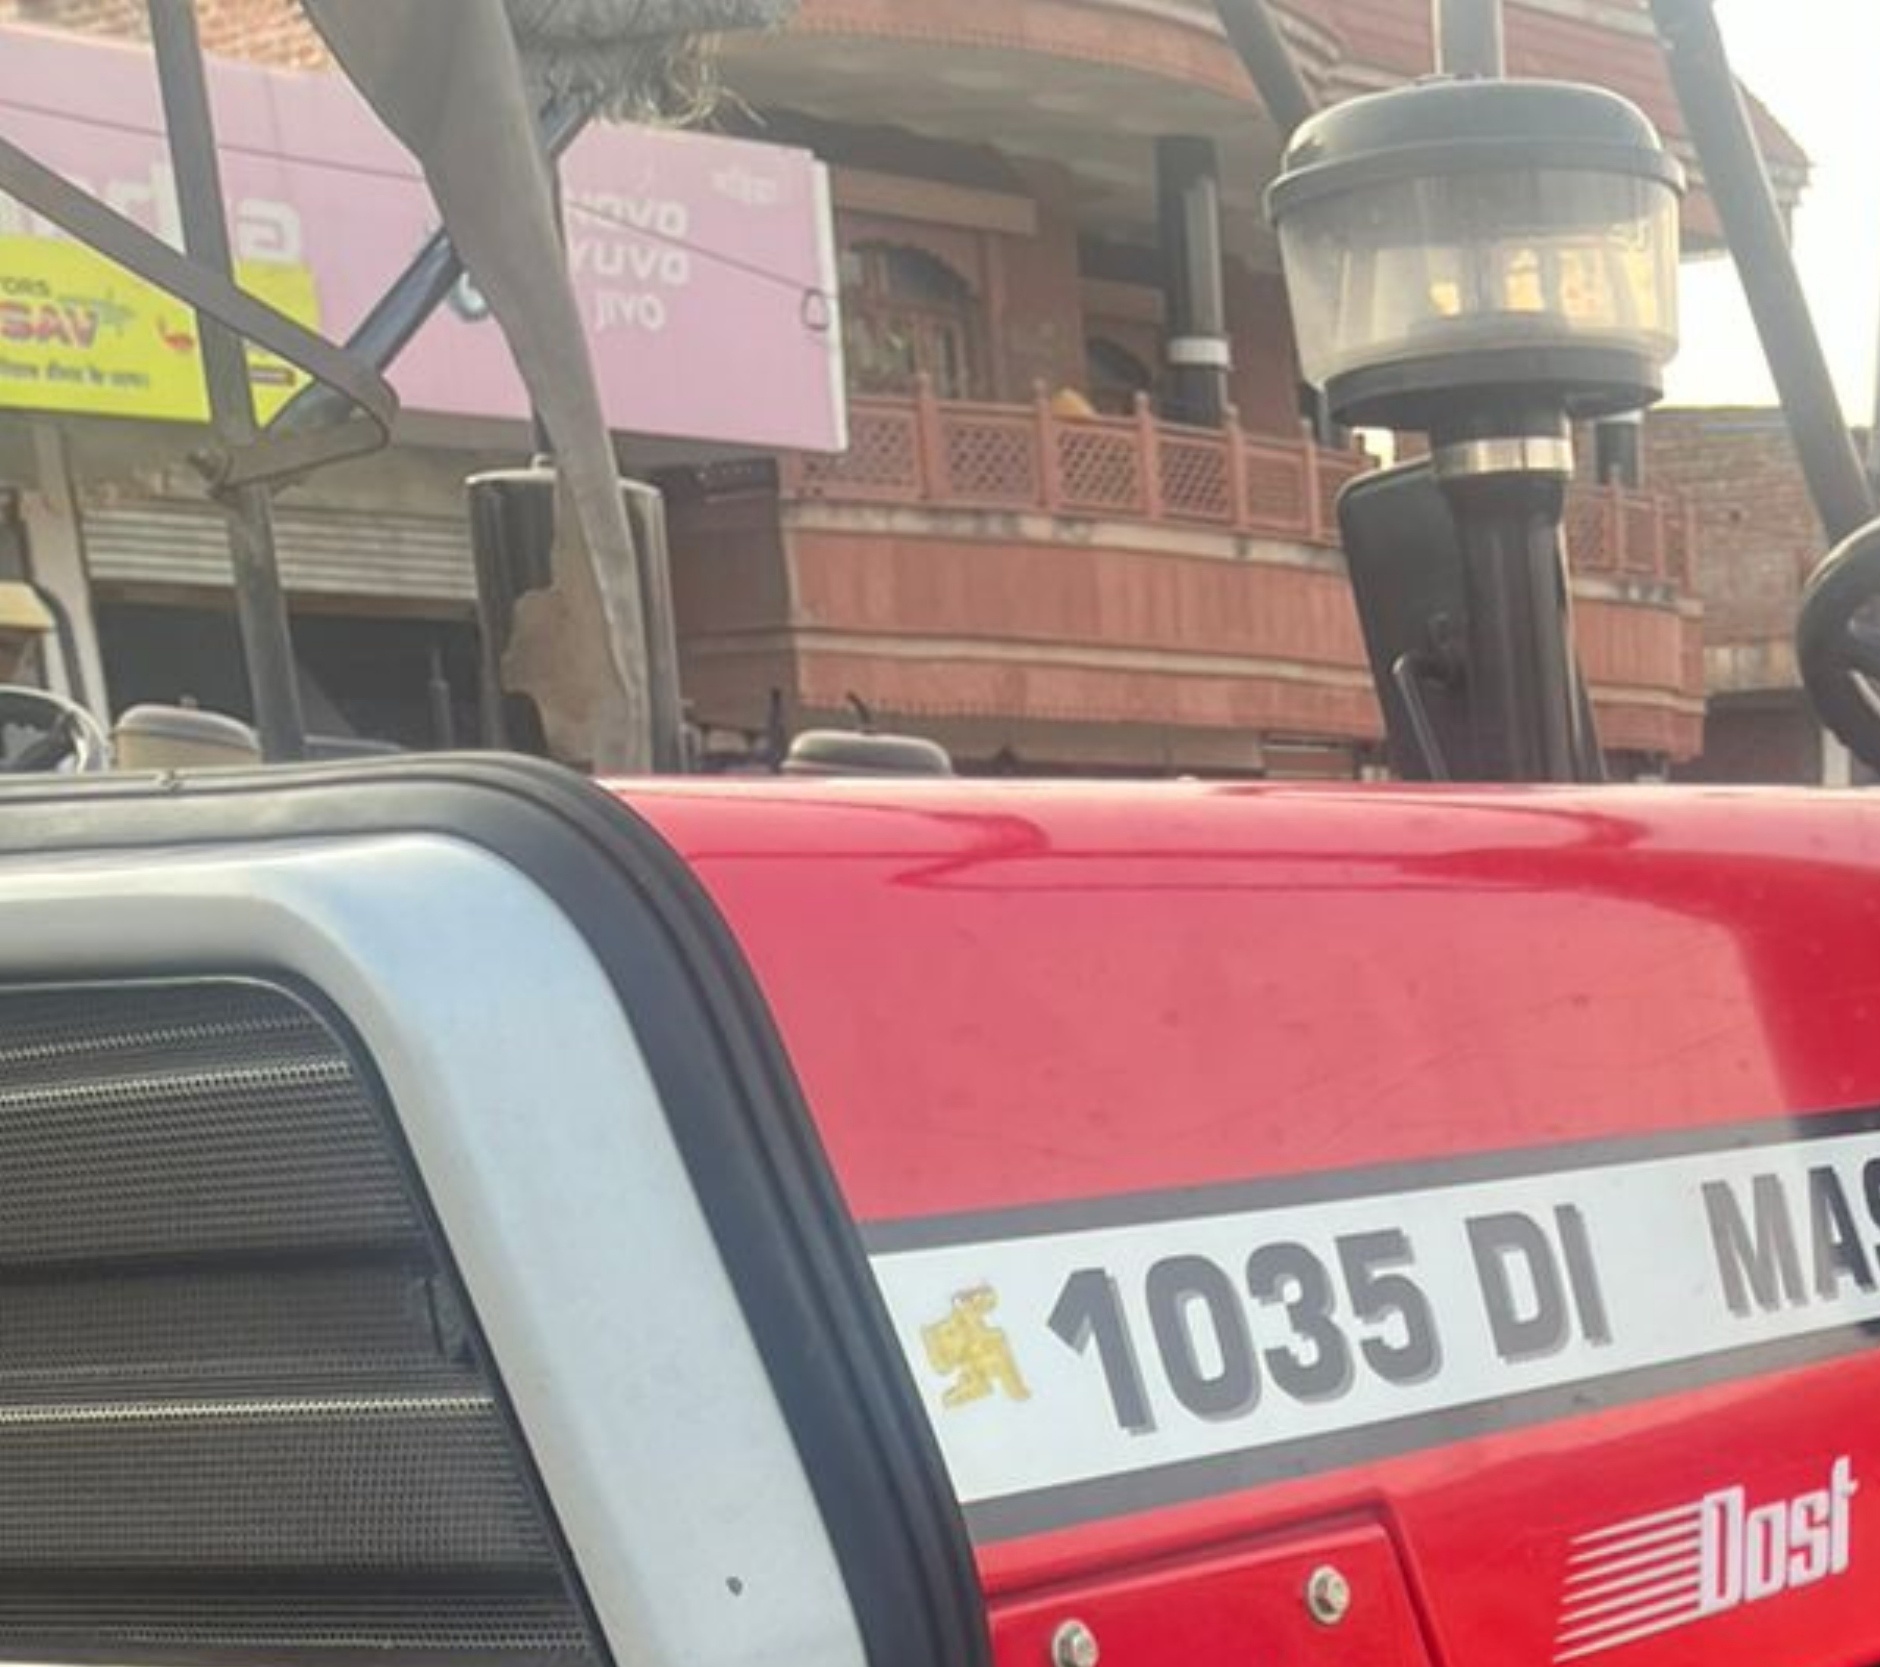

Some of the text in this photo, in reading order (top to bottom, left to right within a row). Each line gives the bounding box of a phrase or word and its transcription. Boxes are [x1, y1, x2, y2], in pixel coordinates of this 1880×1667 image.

[1046, 1226, 1443, 1436] 1035
[1463, 1202, 1613, 1365] DI
[1700, 1454, 1860, 1620] Dost
